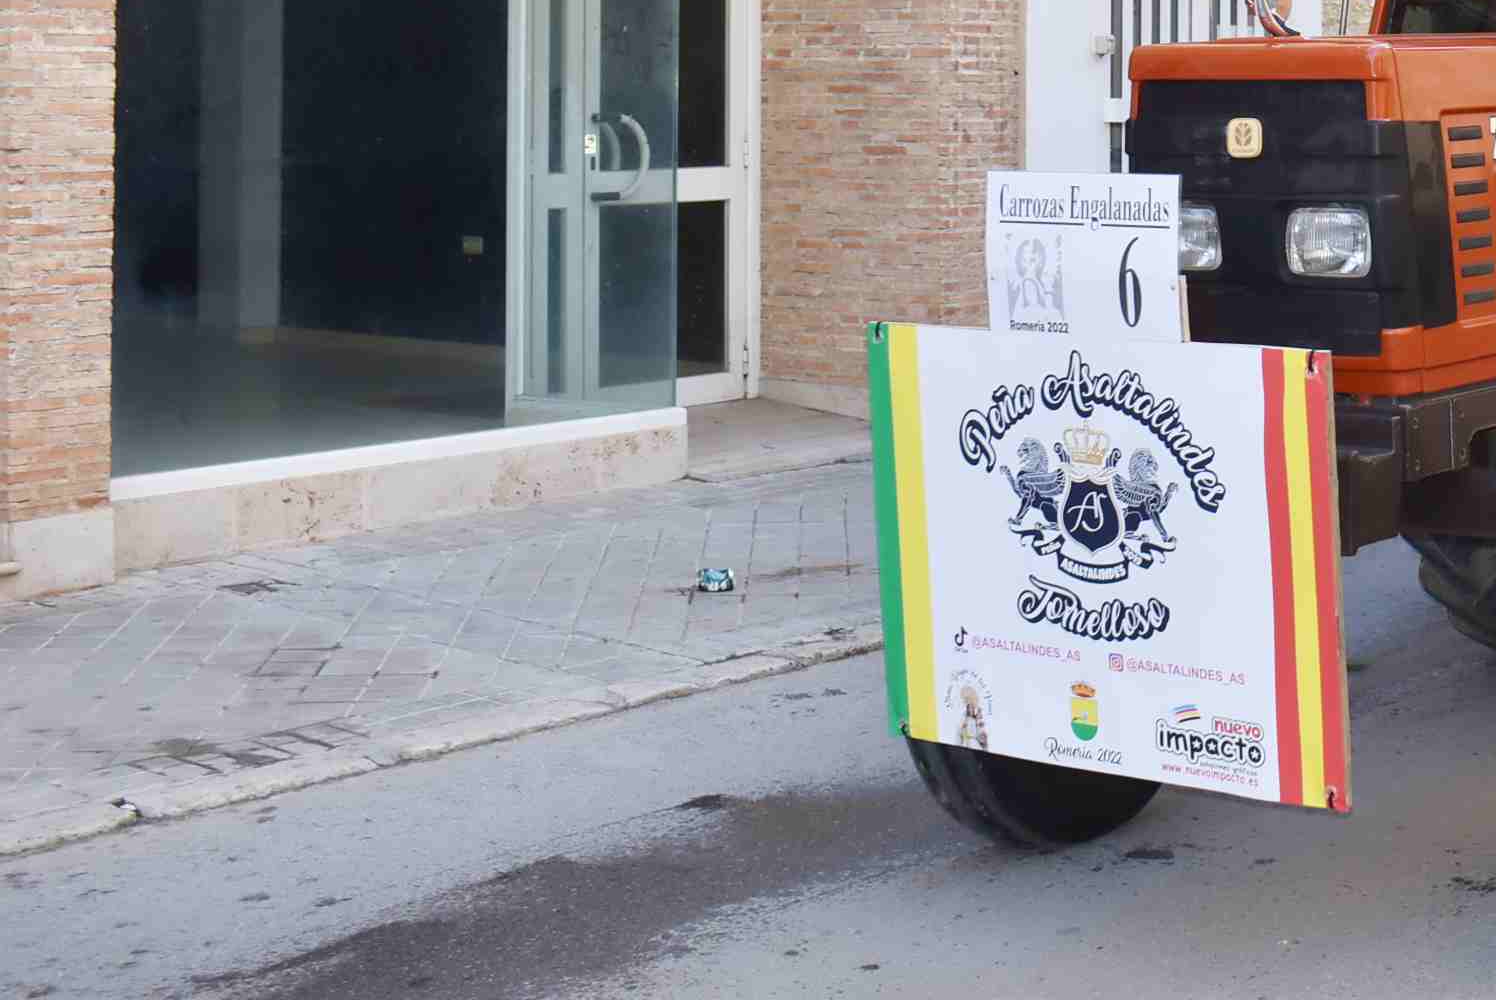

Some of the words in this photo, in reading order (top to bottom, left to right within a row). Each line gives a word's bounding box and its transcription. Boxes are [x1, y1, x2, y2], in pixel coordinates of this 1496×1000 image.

[999, 183, 1065, 218] Carrozas
[1069, 185, 1170, 231] Engalanadas
[1118, 236, 1143, 327] 6
[1047, 320, 1070, 333] 2022
[959, 384, 1035, 473] Peña
[1041, 350, 1226, 513] Asaltalindes
[1017, 574, 1170, 642] Tomelloso
[1126, 657, 1246, 686] @ASALTALINDES_AS
[1158, 723, 1262, 763] impacto
[1214, 718, 1261, 739] nuevo
[1097, 749, 1122, 765] 2022
